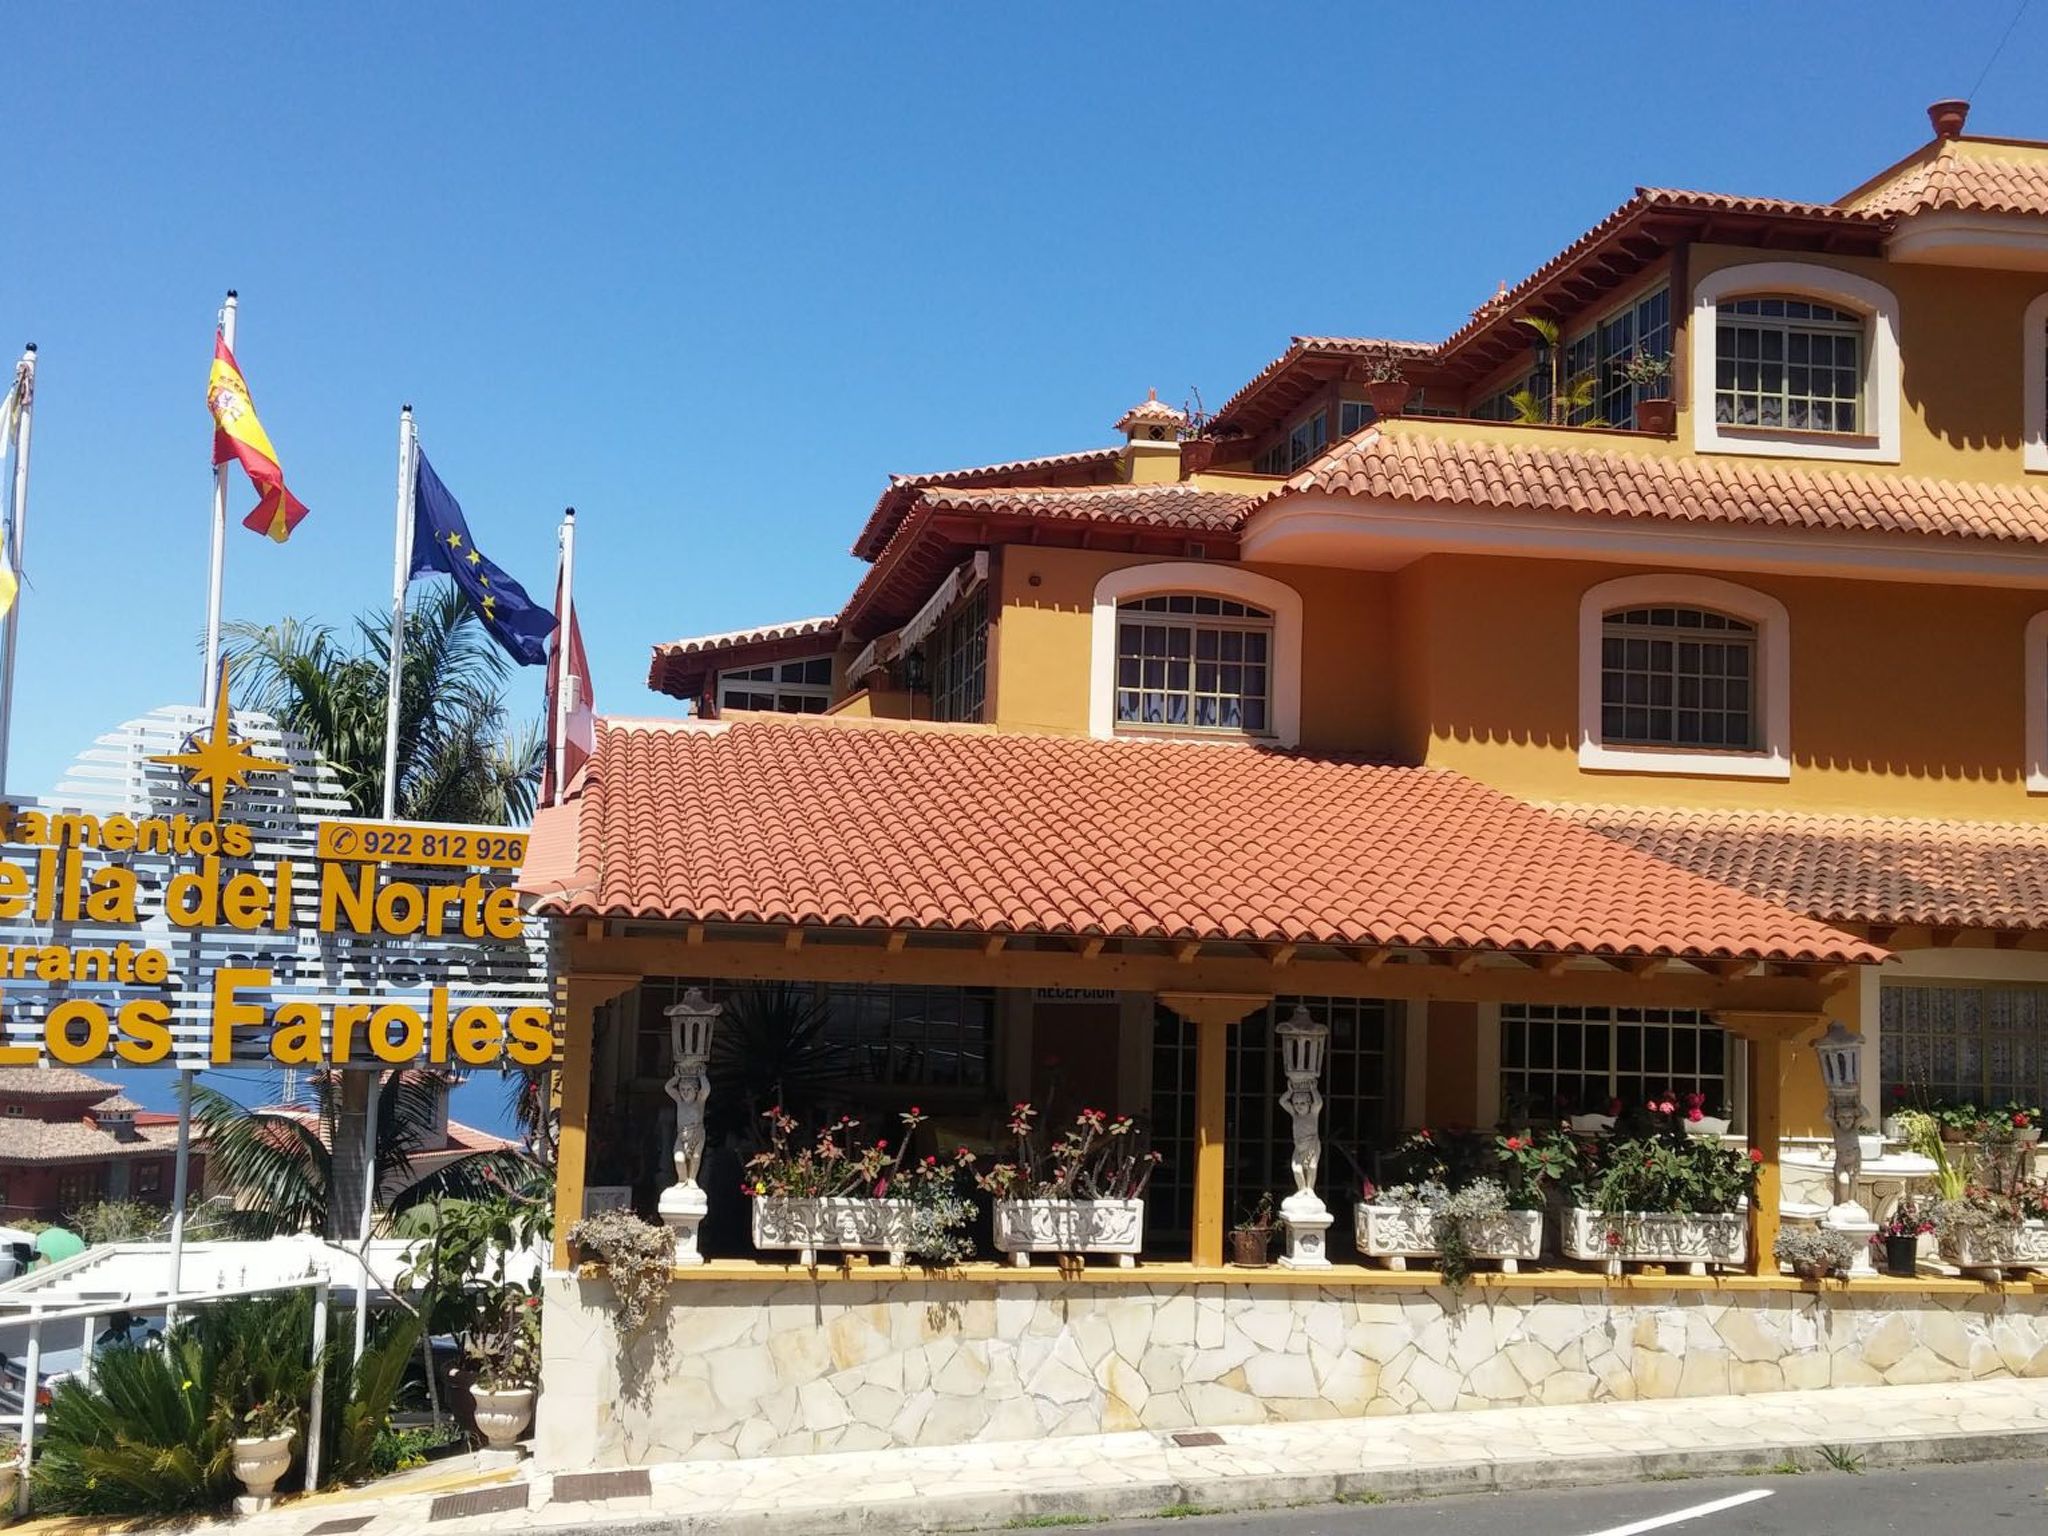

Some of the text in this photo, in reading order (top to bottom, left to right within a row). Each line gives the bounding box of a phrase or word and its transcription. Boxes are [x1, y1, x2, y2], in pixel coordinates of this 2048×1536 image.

[364, 831, 522, 861] 922 812 926
[165, 854, 290, 930] del
[319, 862, 525, 939] Norte
[0, 941, 168, 983] rante
[211, 968, 554, 1064] Faroles
